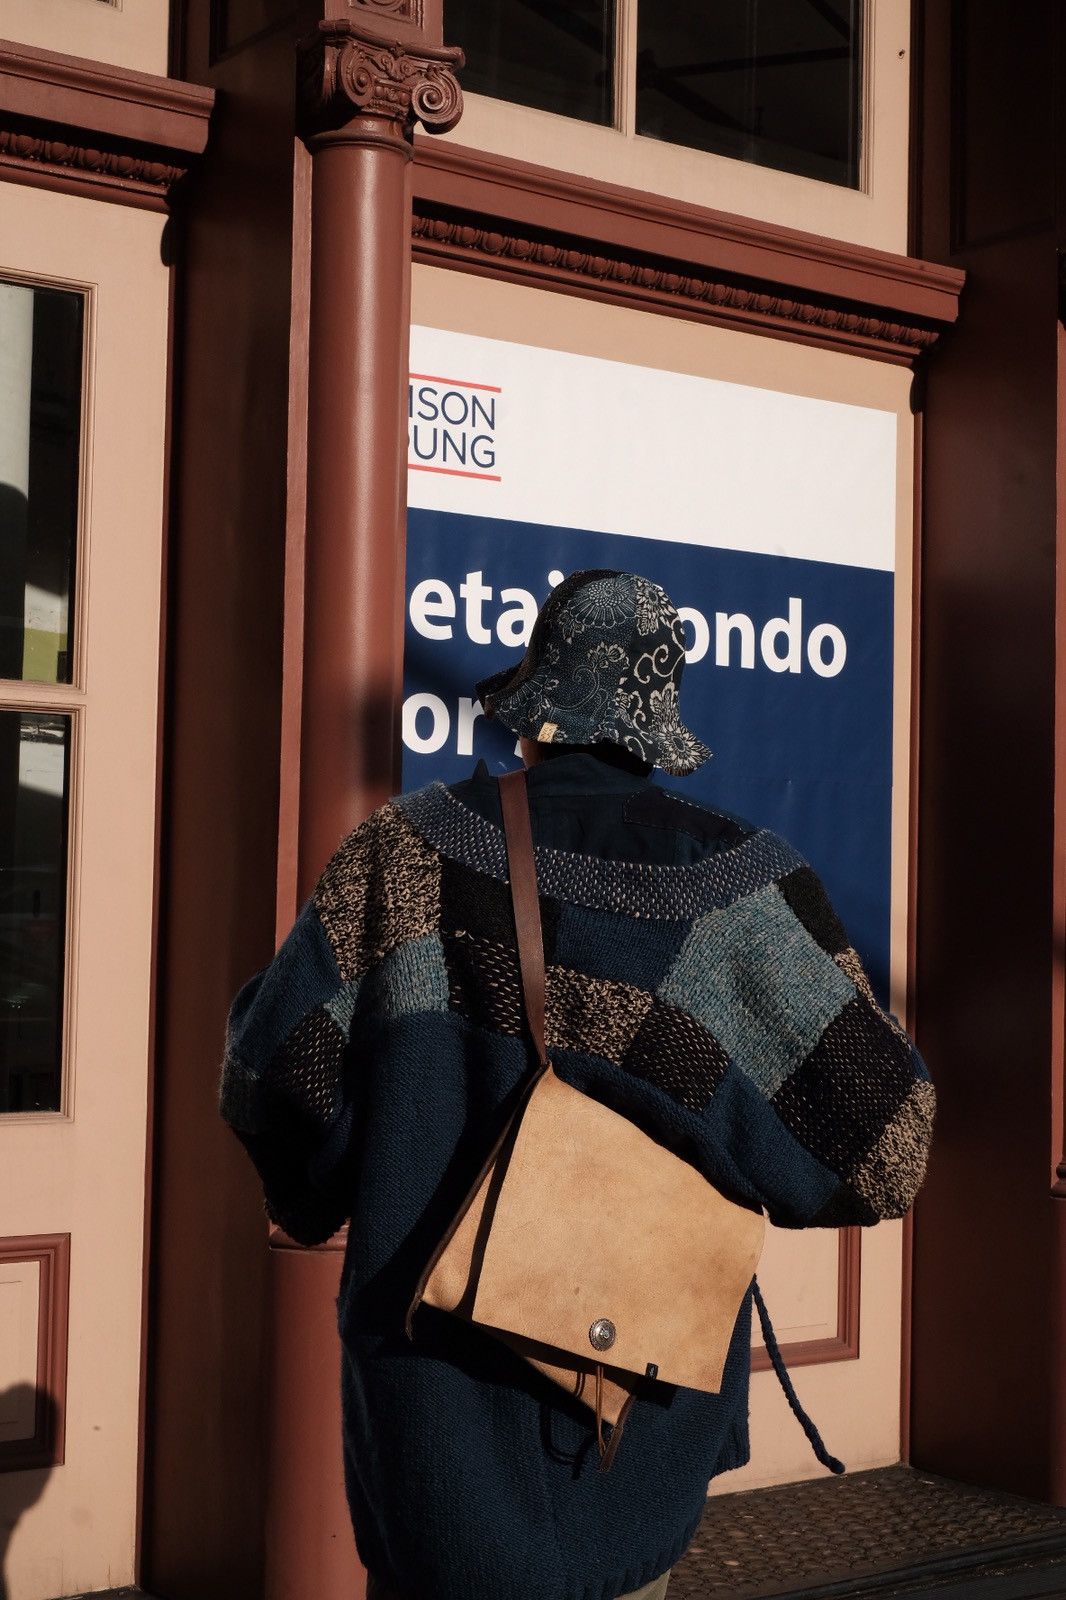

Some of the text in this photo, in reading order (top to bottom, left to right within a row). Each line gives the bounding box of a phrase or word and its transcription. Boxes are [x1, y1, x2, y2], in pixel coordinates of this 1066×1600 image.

[408, 424, 495, 468] UNG
[409, 570, 847, 678] eta ondo
[402, 692, 485, 756] or
